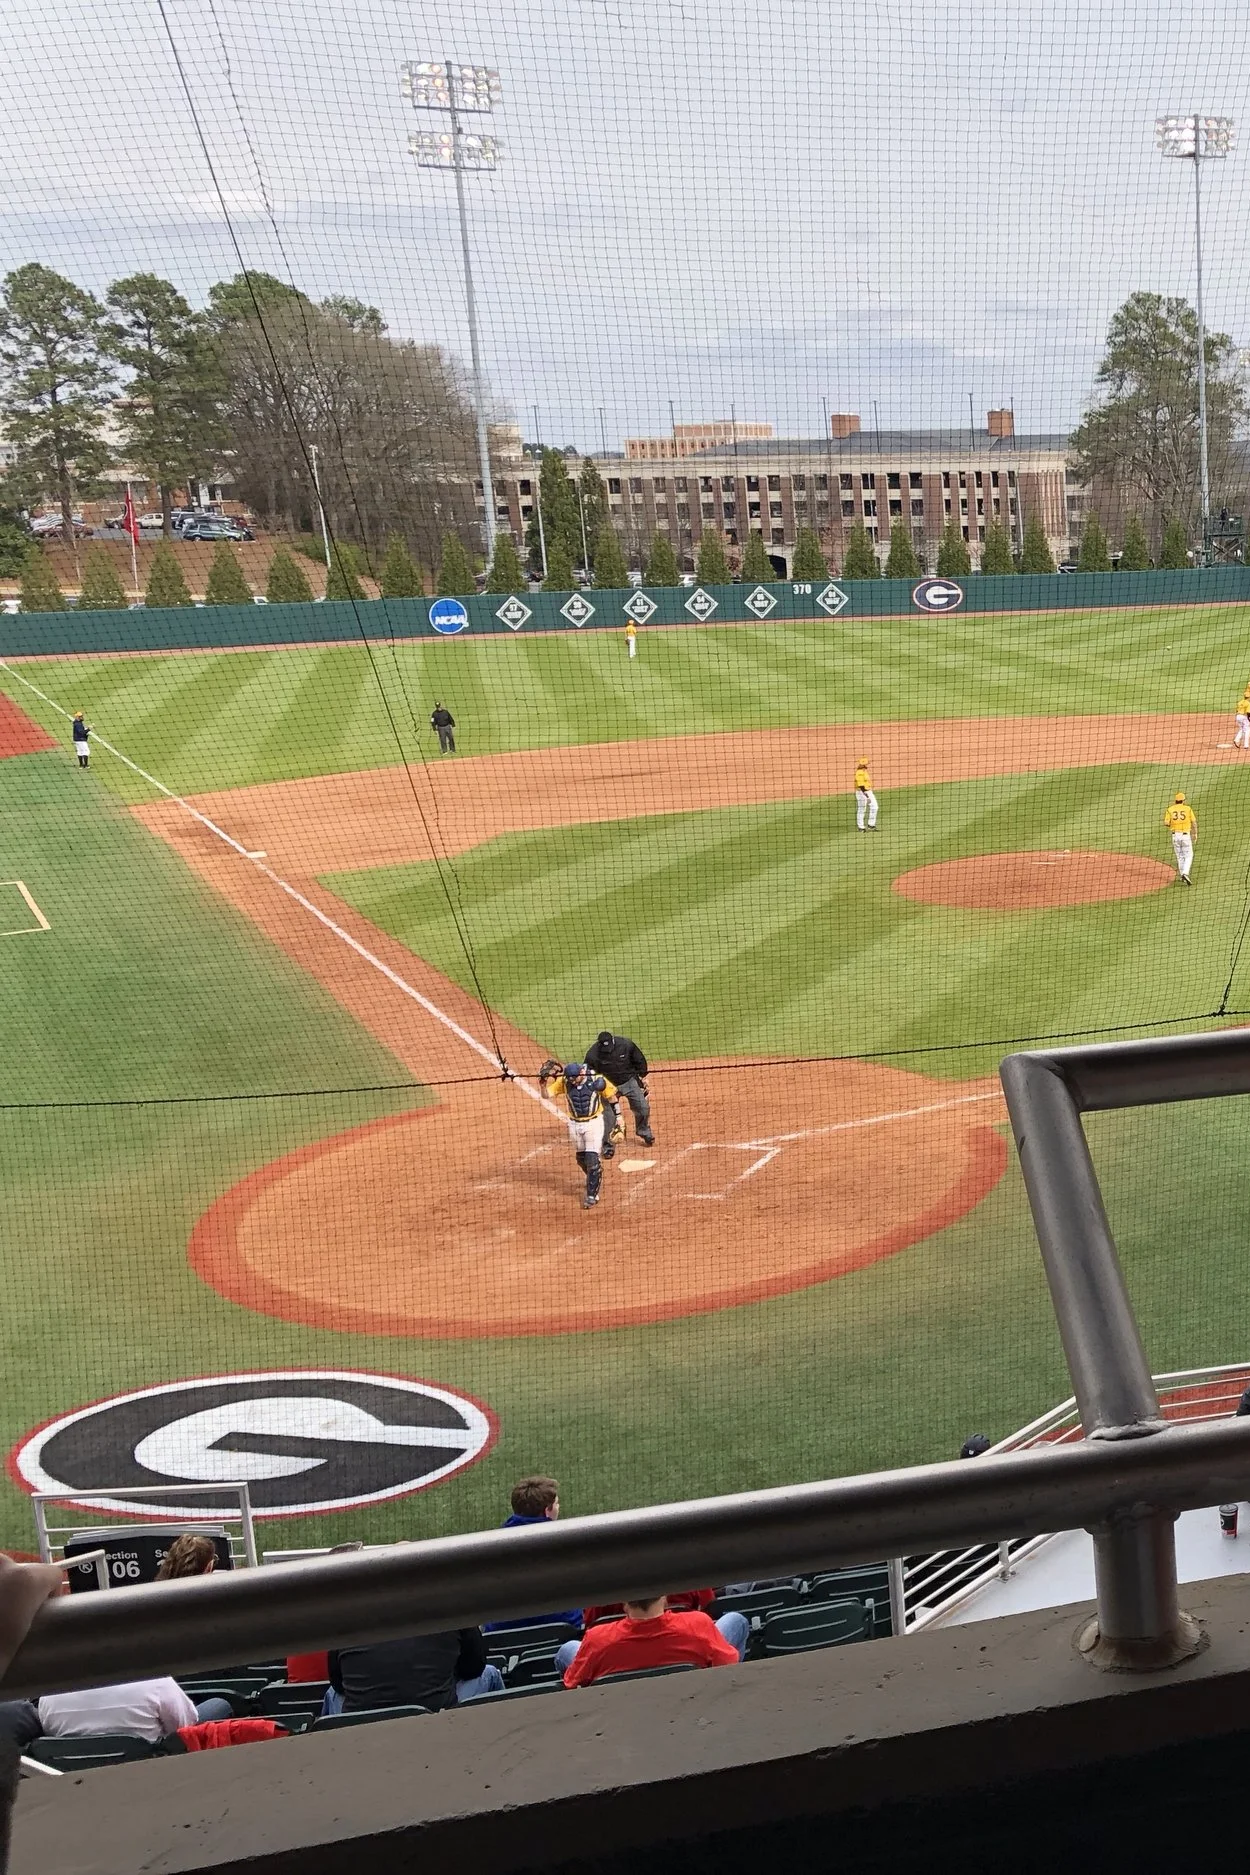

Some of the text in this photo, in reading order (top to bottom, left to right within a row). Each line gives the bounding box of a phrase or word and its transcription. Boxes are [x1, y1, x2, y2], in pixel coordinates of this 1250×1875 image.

[792, 584, 812, 595] 370
[434, 615, 465, 626] NCAA
[1172, 811, 1187, 821] 35
[105, 1551, 138, 1560] ection
[112, 1560, 141, 1579] 06
